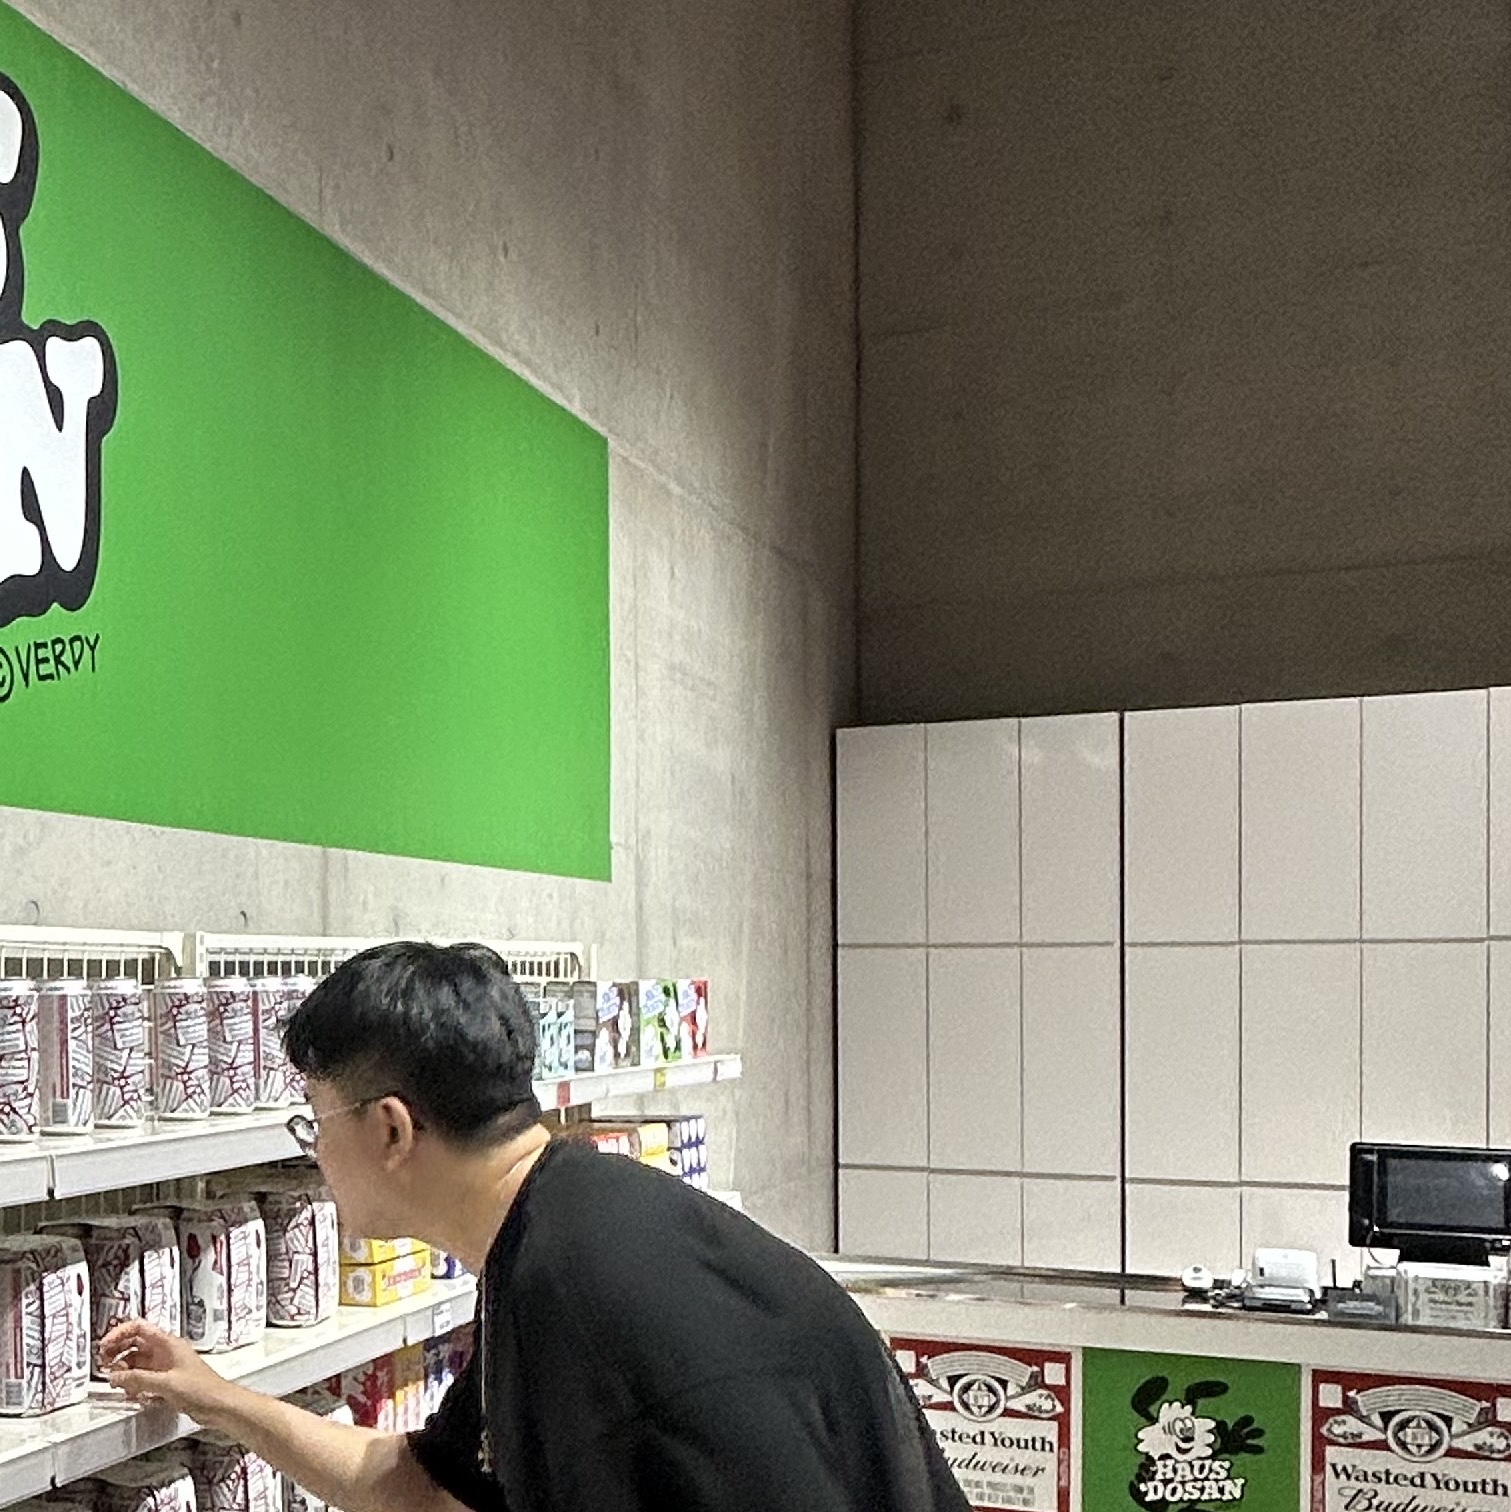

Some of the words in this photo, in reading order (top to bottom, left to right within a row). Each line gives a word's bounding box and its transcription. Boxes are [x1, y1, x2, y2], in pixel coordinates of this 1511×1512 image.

[939, 1428, 985, 1447] sted
[989, 1431, 1055, 1454] Youth
[947, 1452, 1046, 1479] udweiser
[1150, 1458, 1231, 1482] HAUS
[1139, 1478, 1245, 1502] DOSAN
[1330, 1462, 1426, 1489] Wasted
[1429, 1471, 1509, 1497] Youth
